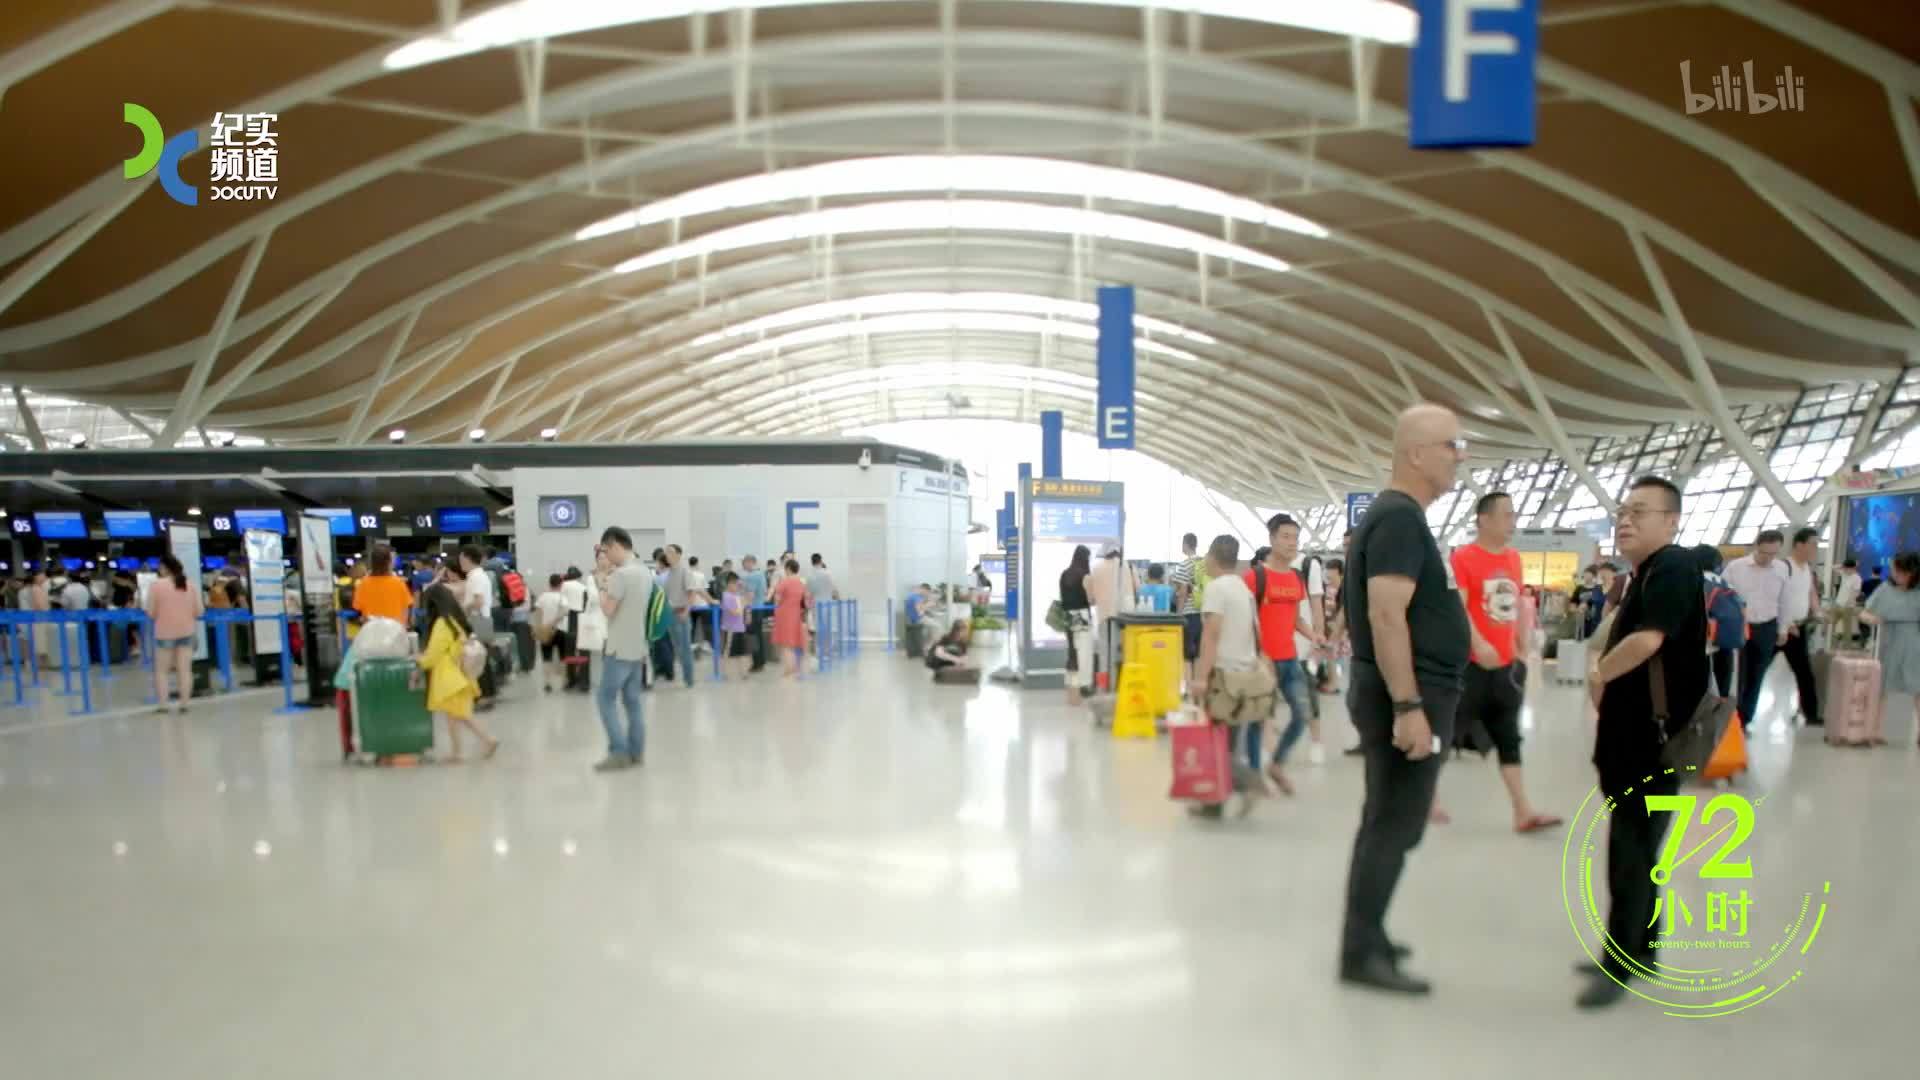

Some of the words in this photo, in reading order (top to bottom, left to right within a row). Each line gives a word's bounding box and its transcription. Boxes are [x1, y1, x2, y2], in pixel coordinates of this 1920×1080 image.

[1444, 0, 1520, 102] F
[1105, 406, 1129, 440] E
[13, 518, 32, 533] 05
[213, 517, 231, 531] 03
[360, 514, 378, 529] 02
[416, 514, 433, 528] 01
[786, 502, 819, 553] F
